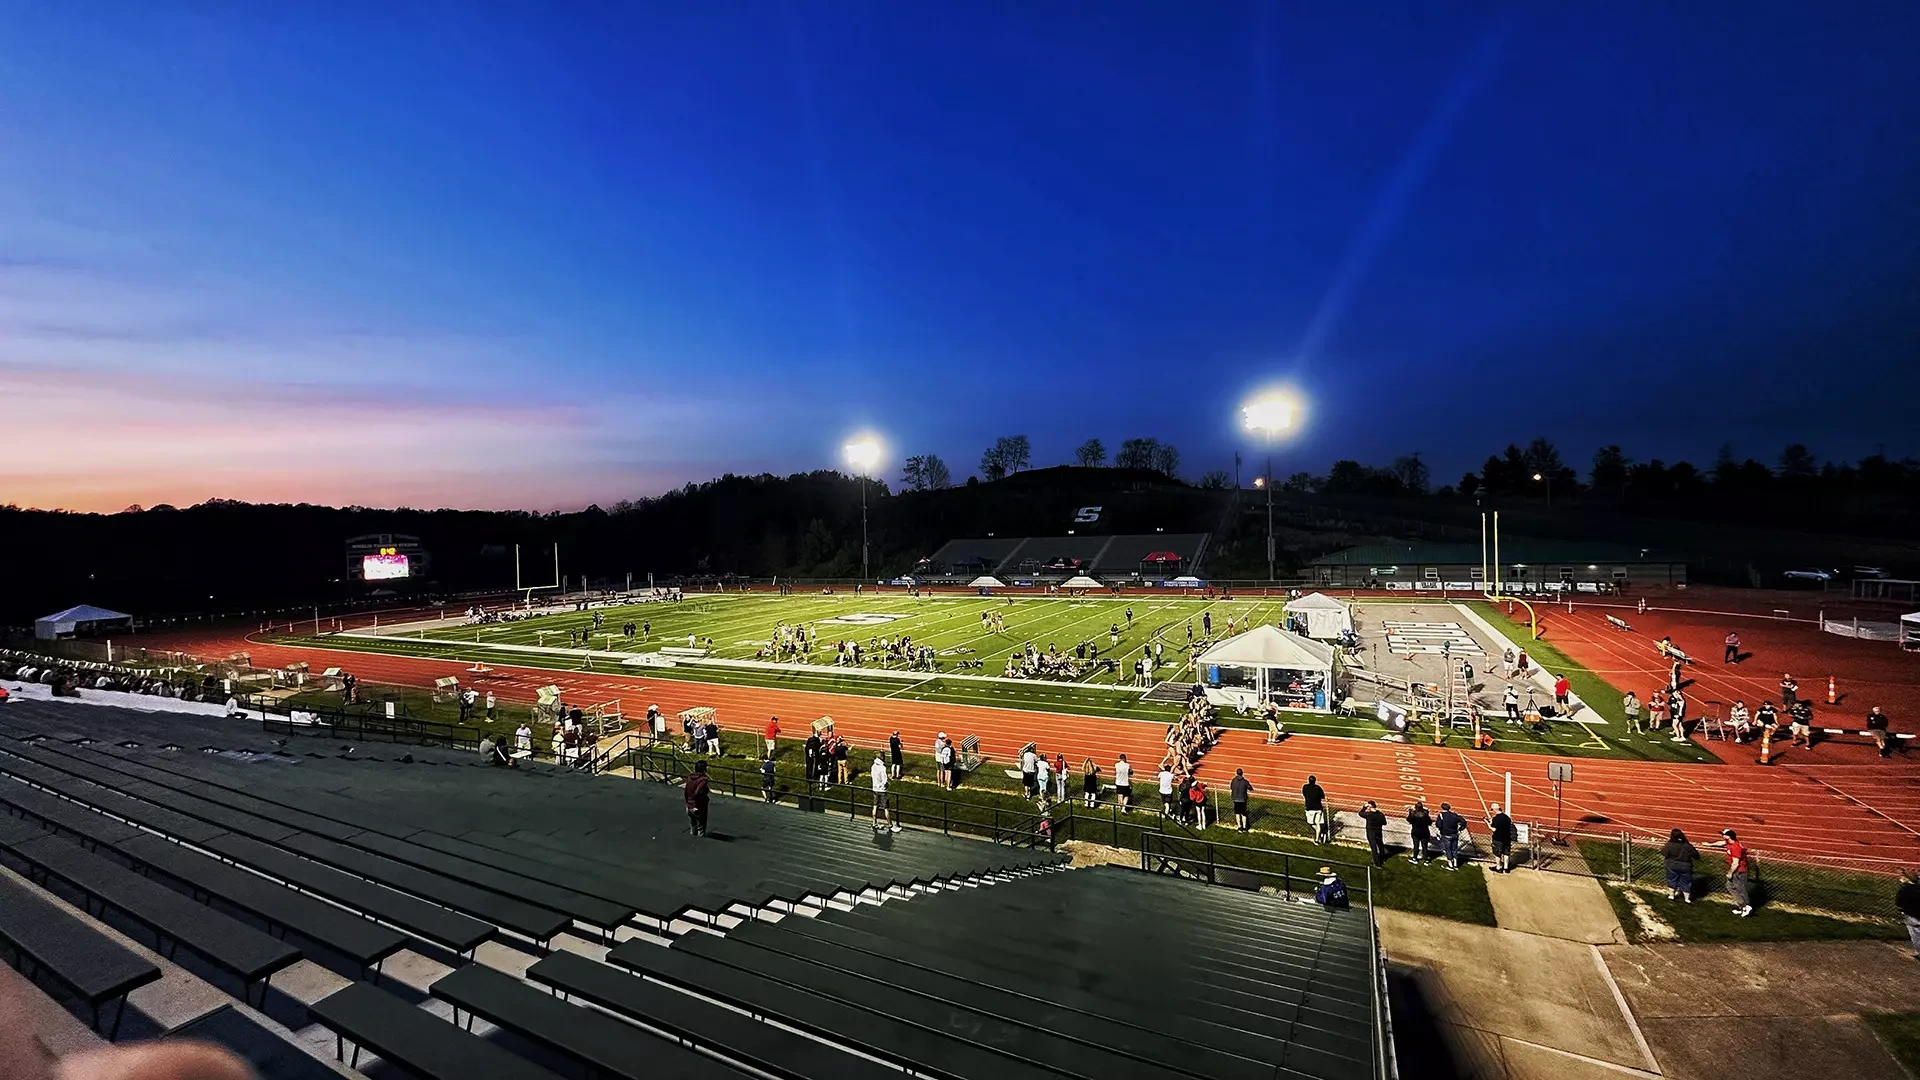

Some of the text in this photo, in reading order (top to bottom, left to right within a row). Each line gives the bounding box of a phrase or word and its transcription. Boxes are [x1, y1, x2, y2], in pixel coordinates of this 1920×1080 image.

[1074, 506, 1103, 523] S
[1398, 766, 1420, 774] 4
[1399, 775, 1423, 783] 5
[1400, 784, 1425, 792] 6
[1402, 794, 1427, 803] 7
